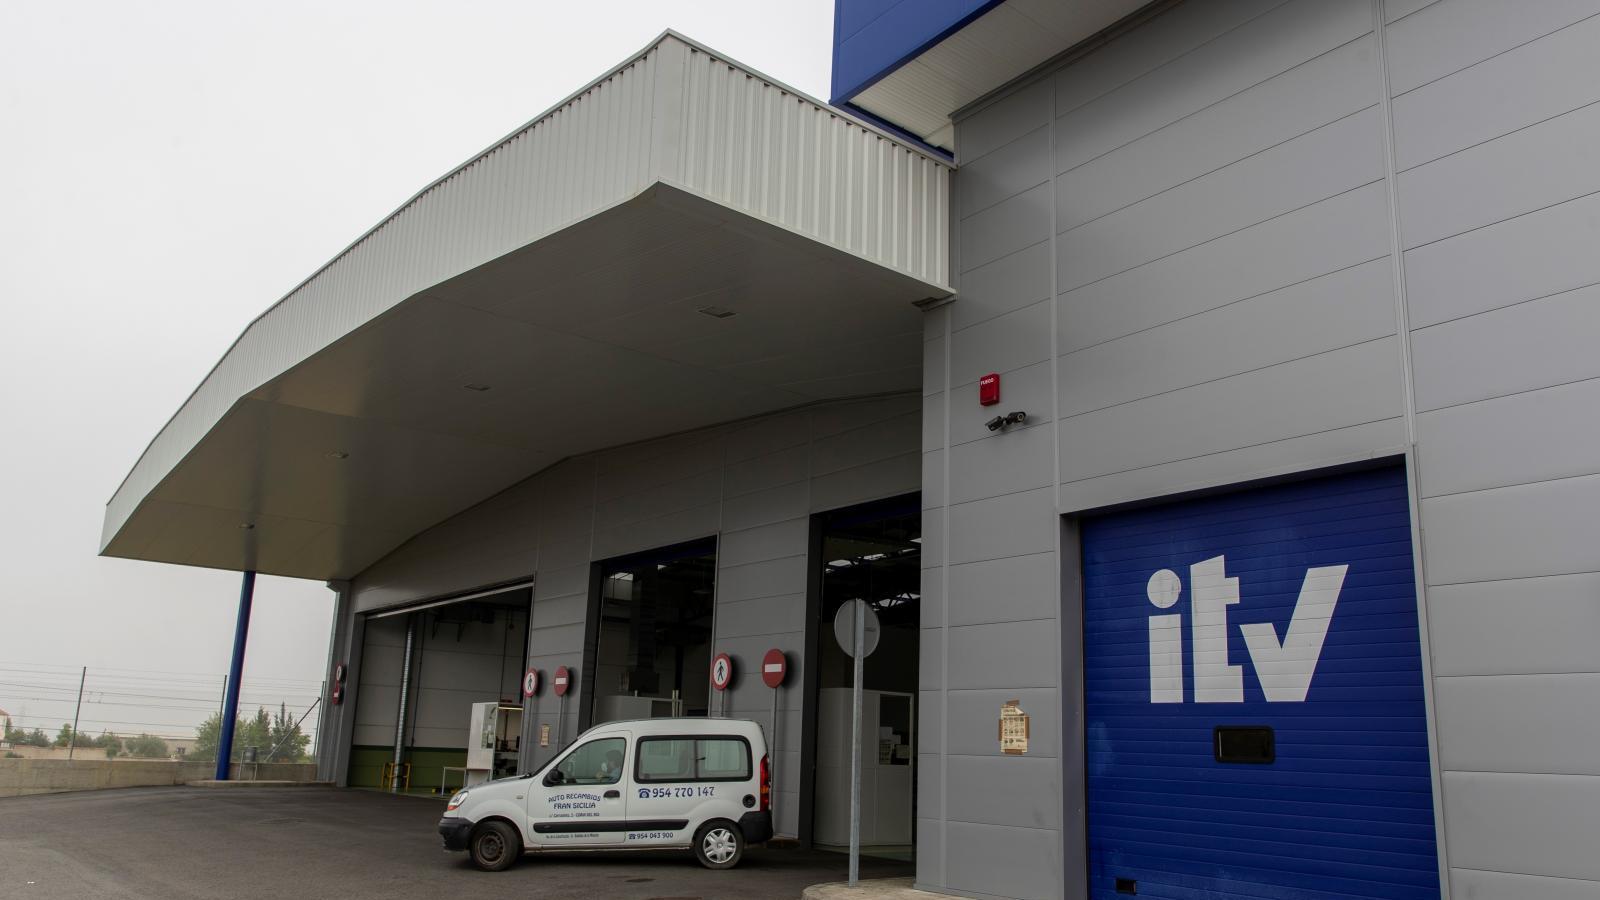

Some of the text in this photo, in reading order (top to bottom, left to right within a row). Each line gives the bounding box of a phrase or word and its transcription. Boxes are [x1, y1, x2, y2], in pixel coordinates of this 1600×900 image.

[1147, 554, 1349, 703] itv
[652, 786, 715, 798] 954 770 147
[548, 793, 601, 803] AUTO RECAMBIOS
[553, 802, 571, 810] FRAN
